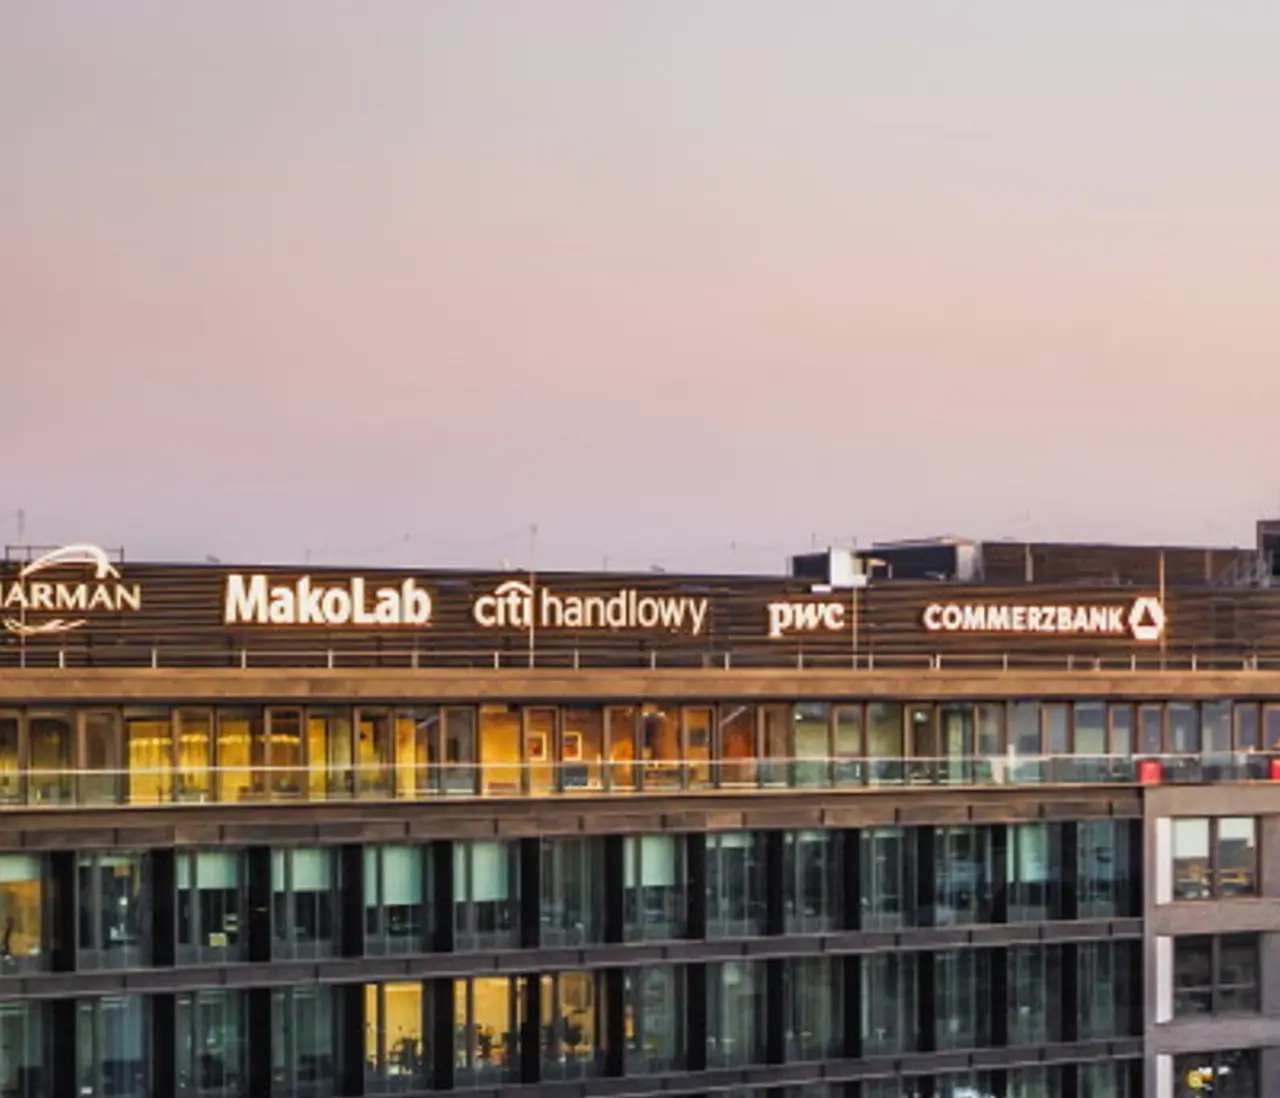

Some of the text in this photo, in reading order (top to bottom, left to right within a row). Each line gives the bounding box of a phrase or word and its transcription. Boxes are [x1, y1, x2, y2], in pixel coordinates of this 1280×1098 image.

[224, 574, 432, 625] MakoLab
[473, 582, 708, 635] citi handlowy
[767, 602, 845, 638] pwc
[923, 604, 1124, 633] COMMERZBANK
